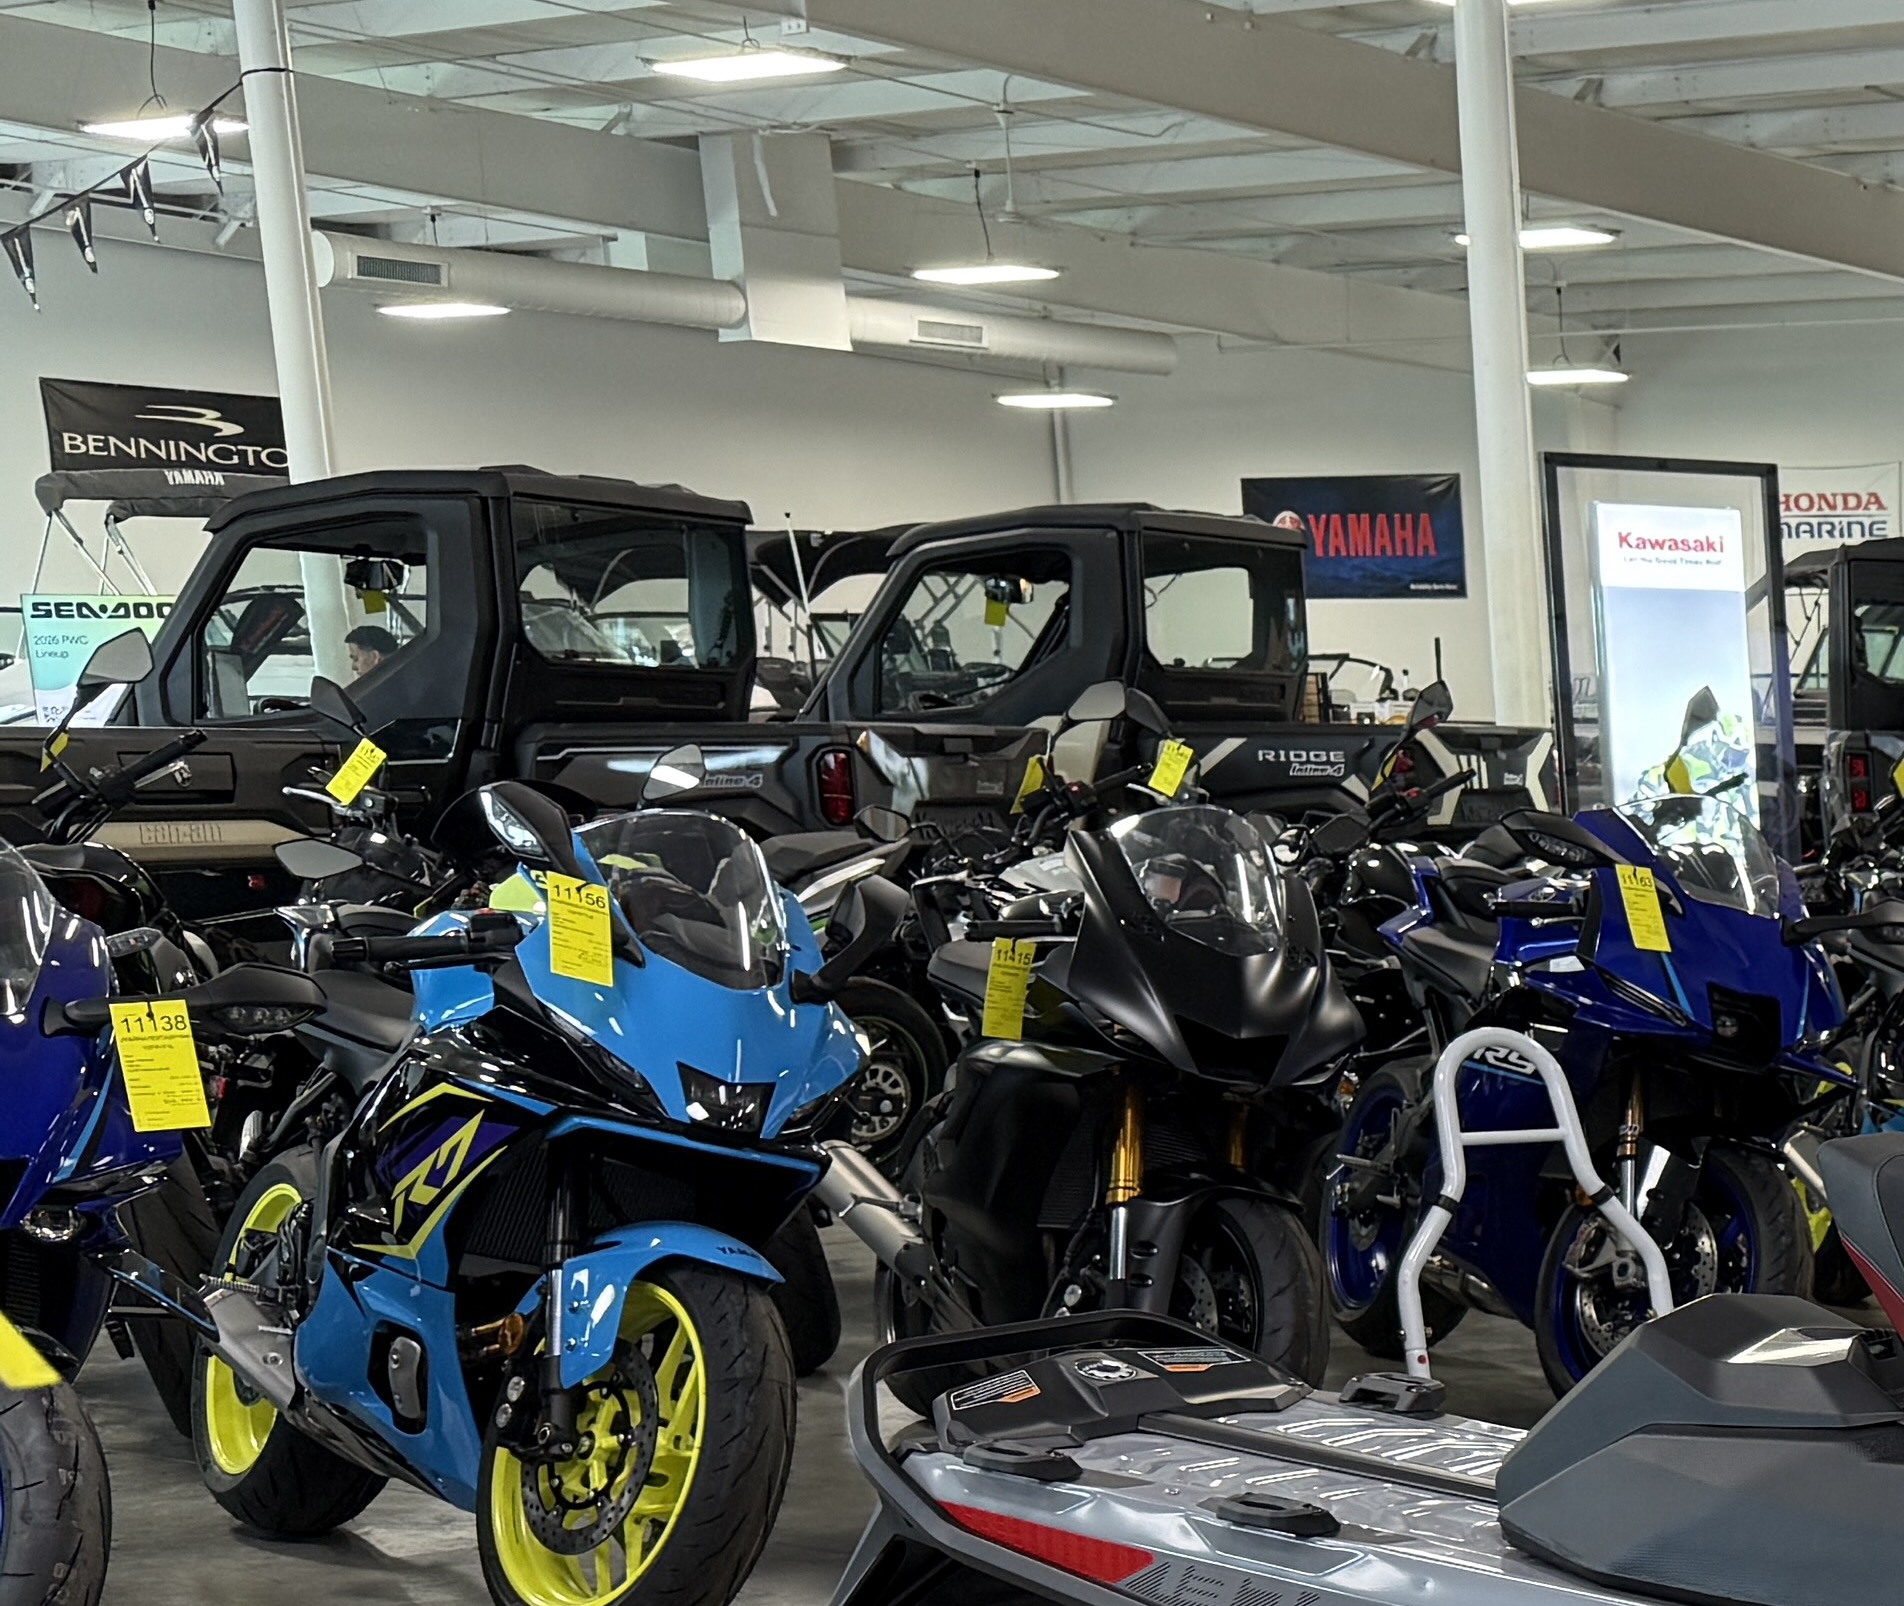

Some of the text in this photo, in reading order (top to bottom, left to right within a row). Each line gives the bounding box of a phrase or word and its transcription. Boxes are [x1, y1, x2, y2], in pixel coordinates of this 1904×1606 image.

[163, 469, 225, 486] YAMAHA
[1307, 513, 1438, 557] YAMAHA
[1618, 532, 1724, 554] Kawasaki
[1259, 750, 1346, 762] RIDGE
[120, 1014, 188, 1034] 11138
